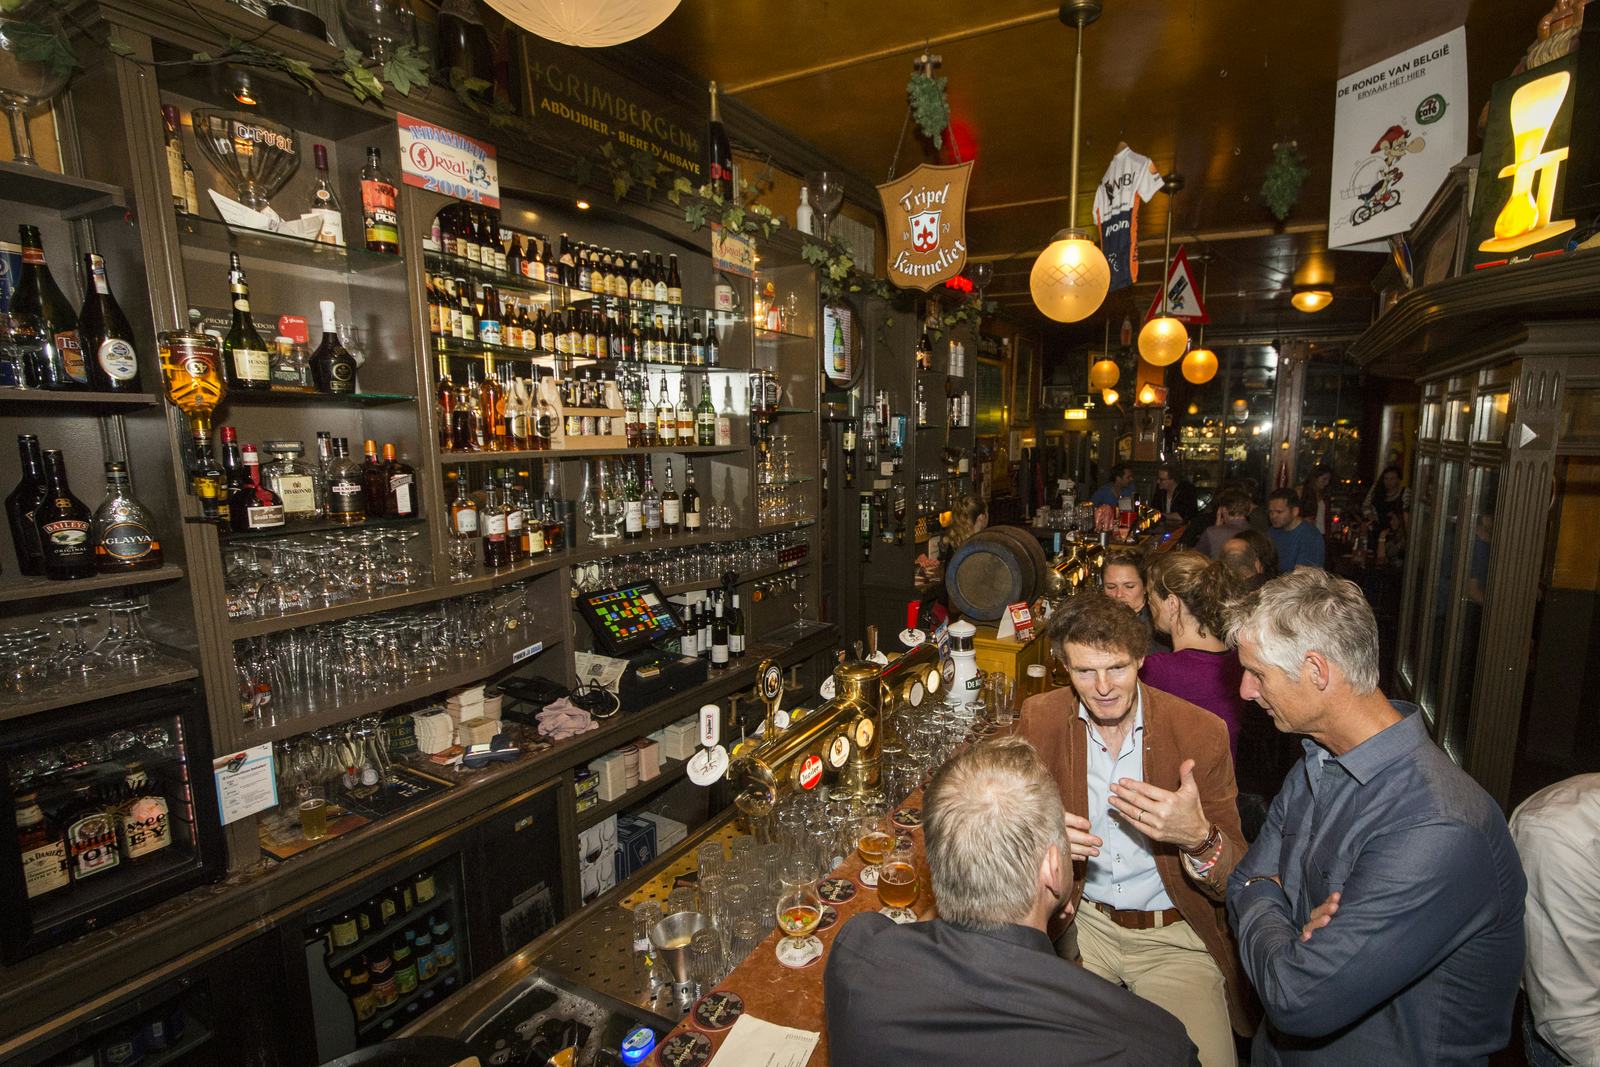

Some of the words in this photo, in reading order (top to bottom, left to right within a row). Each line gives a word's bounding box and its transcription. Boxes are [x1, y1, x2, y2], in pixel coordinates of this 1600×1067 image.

[1337, 87, 1350, 98] DE
[1352, 72, 1386, 92] RONDE
[1388, 62, 1411, 77] VAN
[1413, 43, 1450, 68] BELGIË
[1357, 83, 1388, 100] ERVAAR
[1389, 76, 1405, 89] HET
[1407, 68, 1426, 80] HIER
[900, 183, 950, 212] Tripel
[893, 239, 965, 277] Karmeliet
[58, 336, 80, 350] TEX
[46, 521, 87, 532] BAILEYS
[106, 535, 152, 545] GLAYVA
[801, 767, 820, 783] Jupiler
